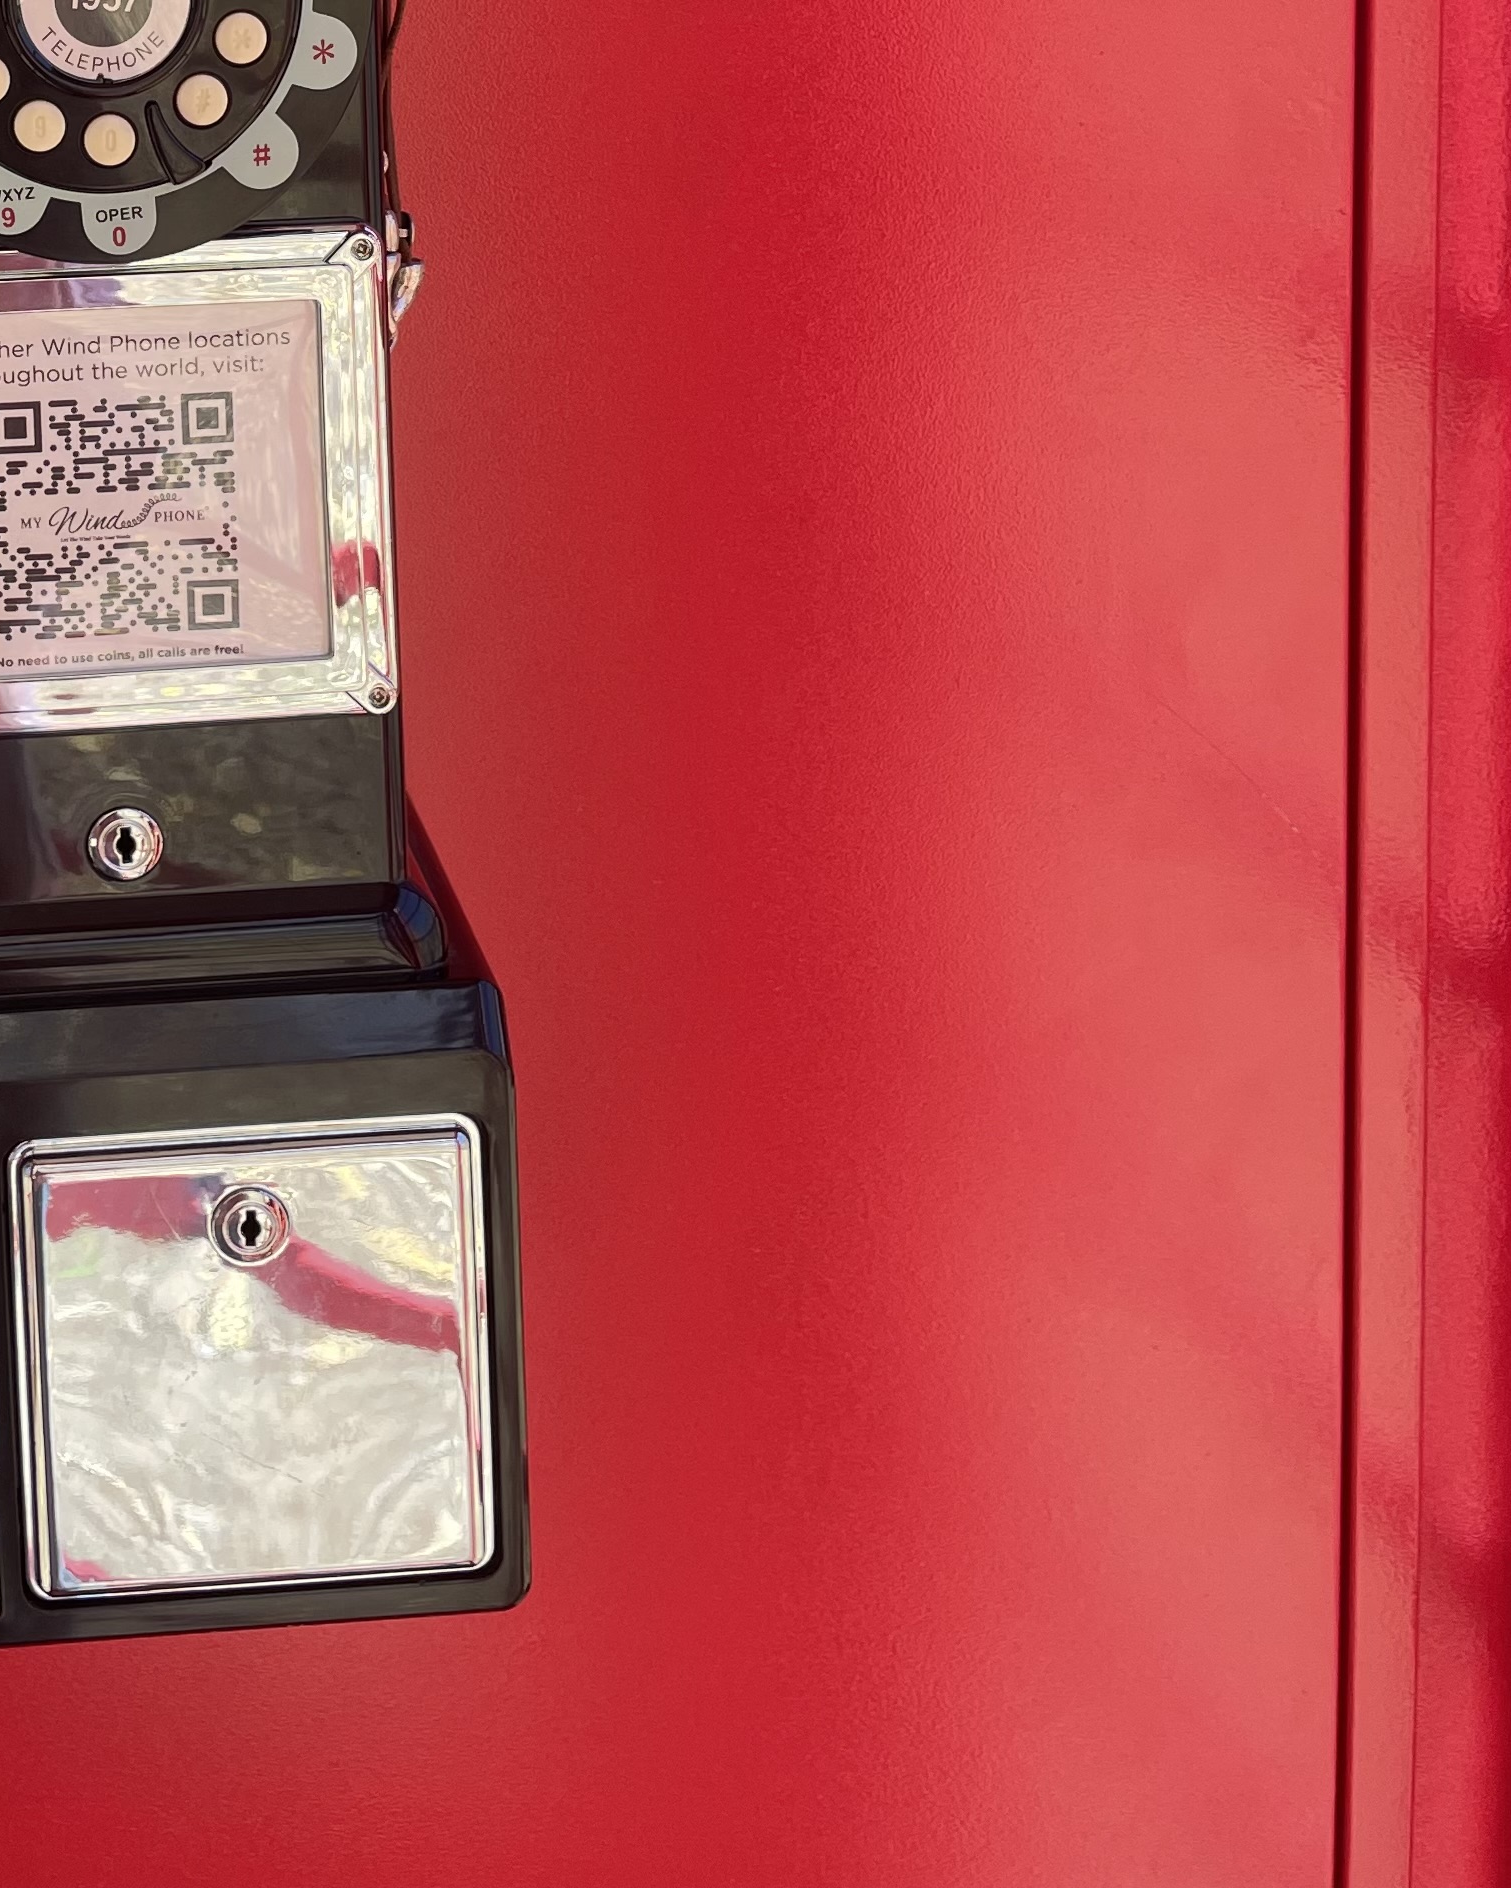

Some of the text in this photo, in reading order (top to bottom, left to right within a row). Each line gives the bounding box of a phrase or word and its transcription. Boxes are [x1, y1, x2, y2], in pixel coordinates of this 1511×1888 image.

[40, 25, 165, 73] TELEPHONE
[2, 208, 16, 228] 9
[95, 205, 143, 222] OPER
[112, 227, 126, 247] 0
[41, 335, 102, 357] Wind
[110, 334, 180, 353] Phone
[189, 328, 290, 351] locations
[91, 361, 128, 381] the
[135, 356, 204, 378] world,
[212, 355, 263, 374] visit:
[20, 506, 206, 536] MY Wind PHONE
[18, 655, 50, 666] need
[54, 655, 68, 664] to
[72, 654, 93, 663] use
[97, 650, 134, 662] coins,
[138, 648, 153, 659] all
[157, 646, 186, 658] calls
[190, 647, 211, 656] are
[214, 643, 244, 656] free!
